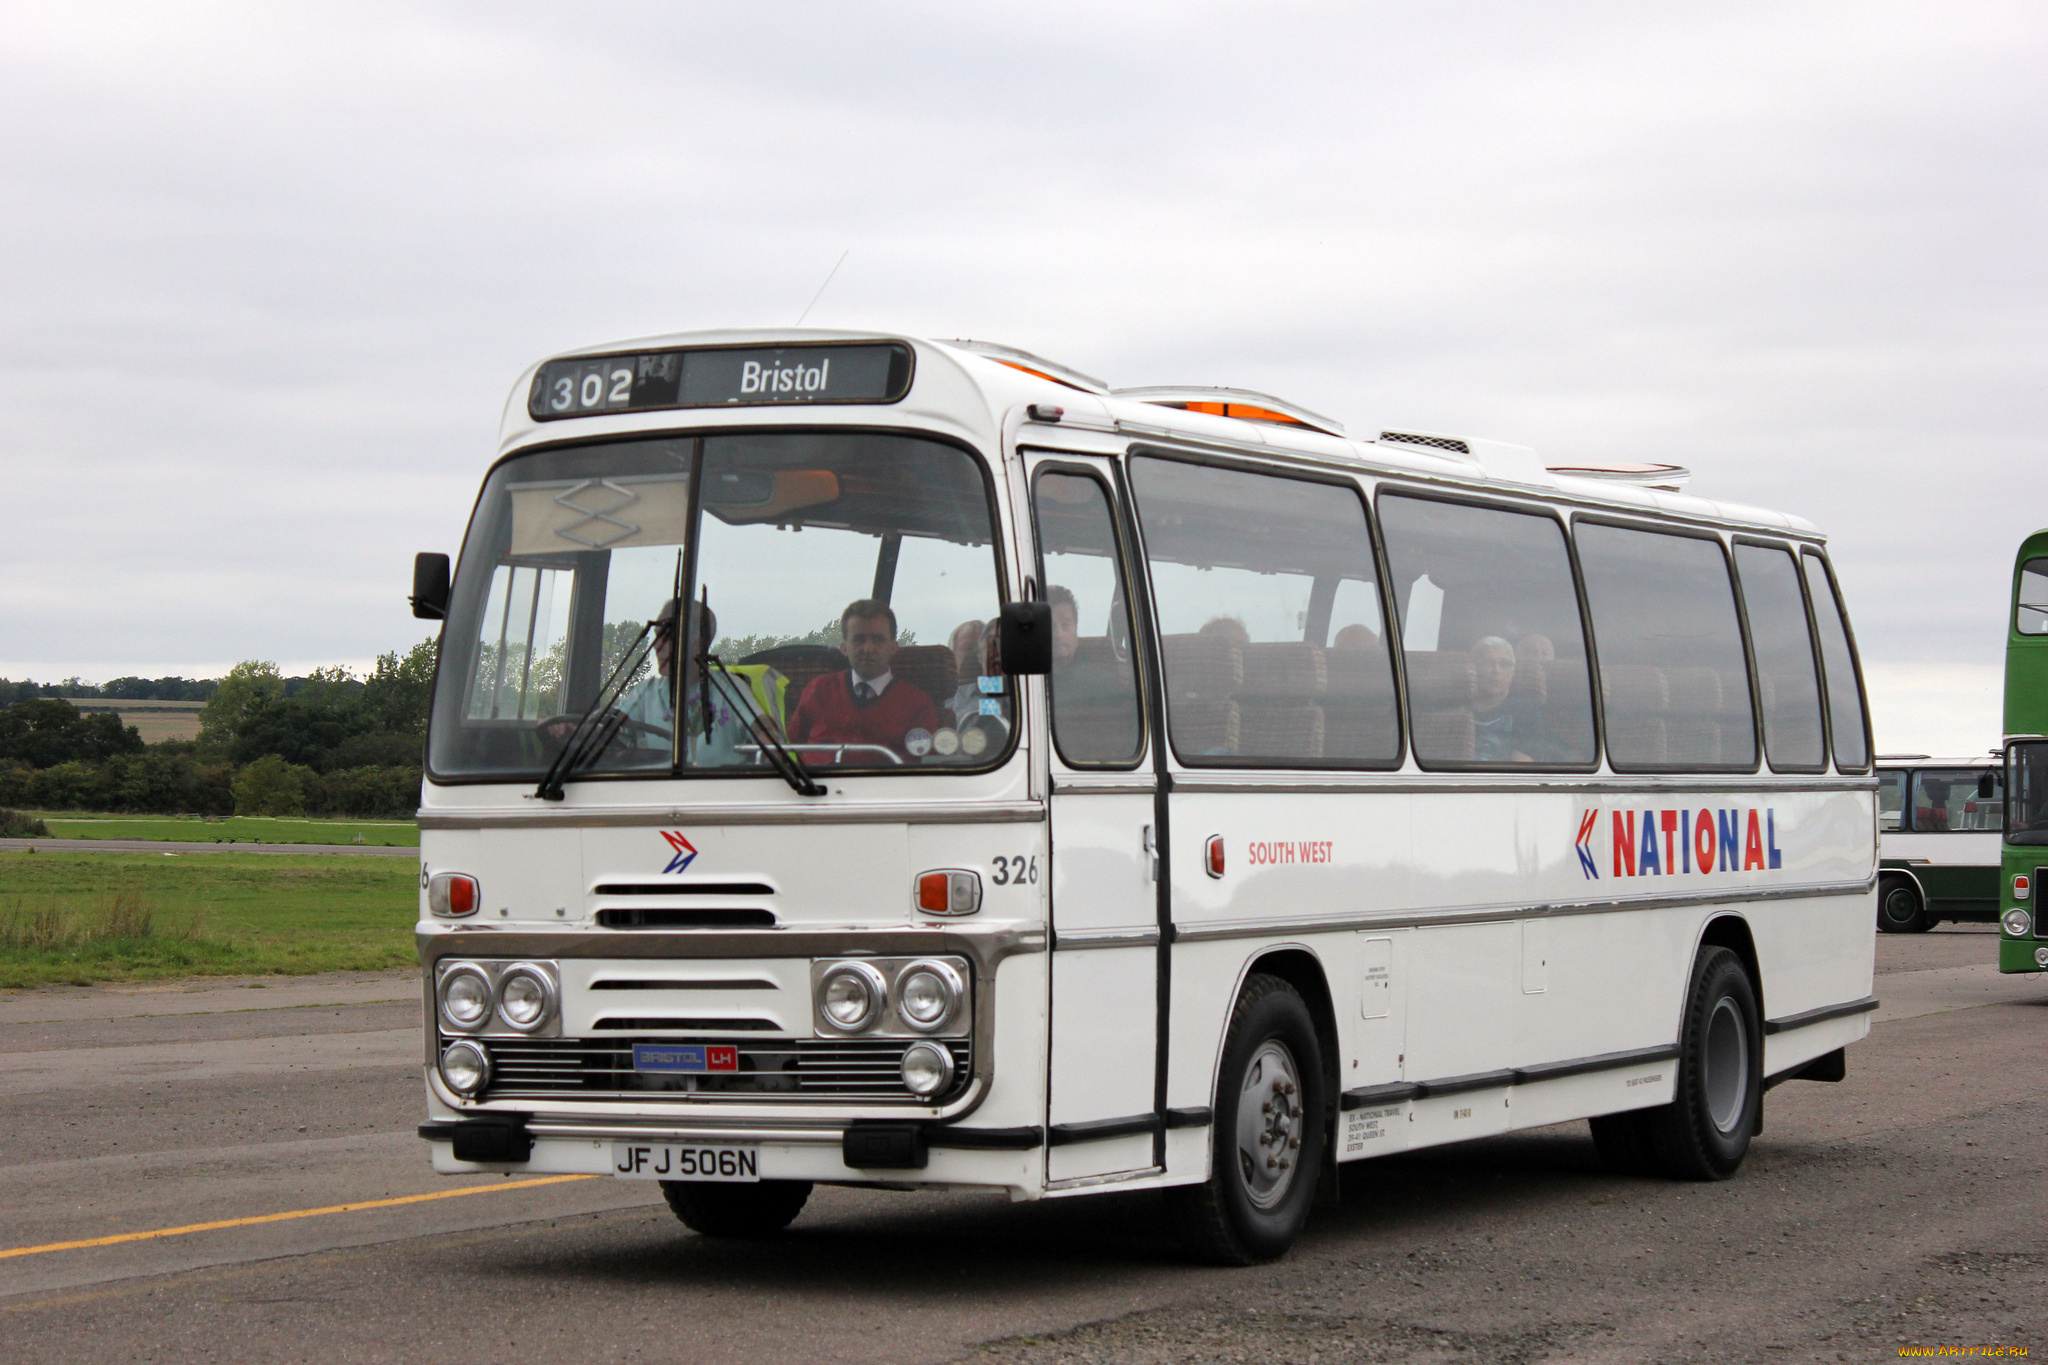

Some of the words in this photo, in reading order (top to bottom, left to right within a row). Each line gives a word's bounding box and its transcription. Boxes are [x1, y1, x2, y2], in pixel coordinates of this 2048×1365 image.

[551, 368, 633, 411] 302
[740, 358, 829, 393] Bristol
[1249, 842, 1295, 865] SOUTH
[1299, 841, 1333, 863] WEST
[1612, 808, 1782, 878] NATIONAL
[992, 855, 1038, 886] 326
[640, 1052, 702, 1064] BRISTOL
[711, 1053, 731, 1064] LH
[617, 1147, 670, 1174] JFJ
[680, 1148, 757, 1176] 506N
